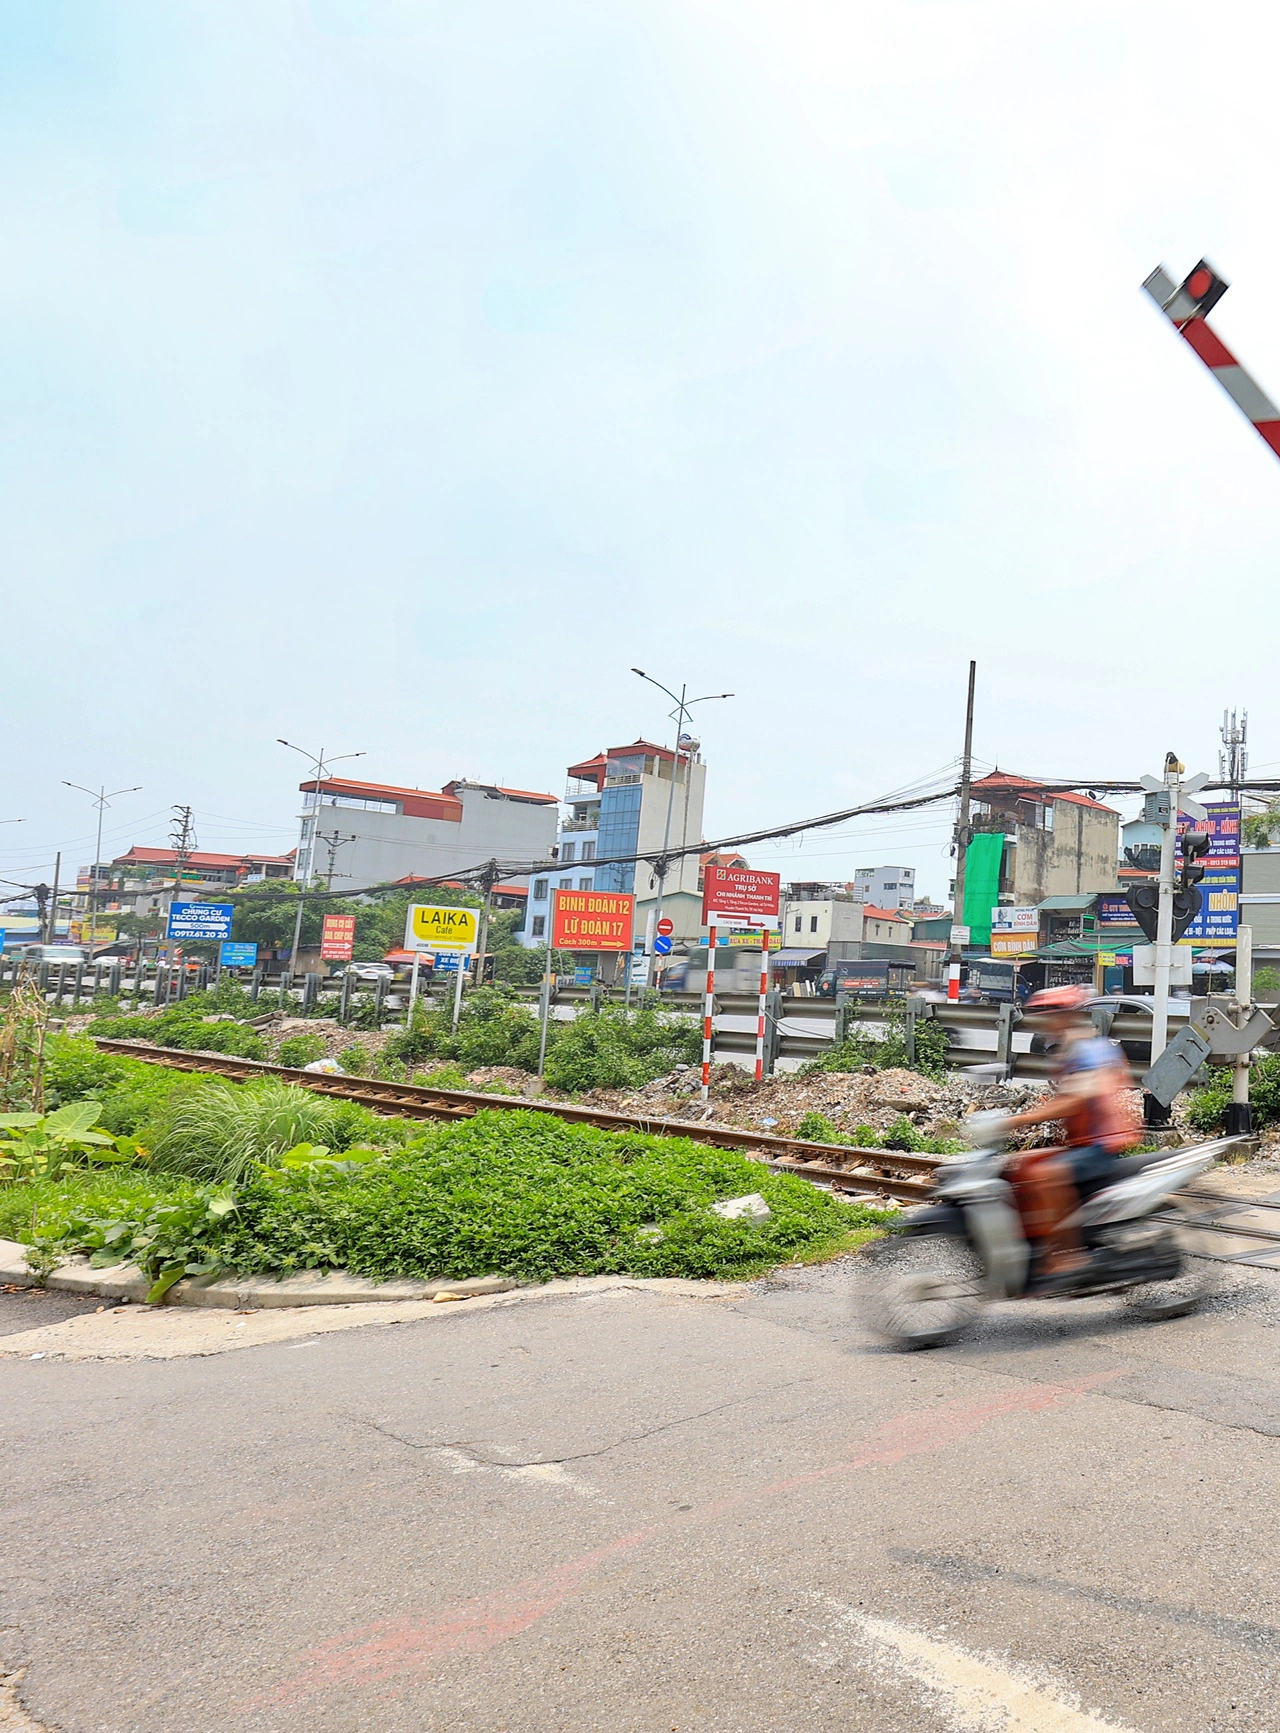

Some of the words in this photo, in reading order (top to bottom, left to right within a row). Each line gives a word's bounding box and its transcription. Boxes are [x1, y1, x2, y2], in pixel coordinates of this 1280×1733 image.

[727, 874, 774, 886] AGRIBANK
[559, 896, 585, 912] BINH
[588, 896, 616, 913] ĐOÀN
[618, 900, 629, 914] 12
[1208, 888, 1237, 912] NHÔM
[421, 910, 468, 926] LAIKA
[564, 916, 579, 934] LỮ
[581, 917, 610, 935] ĐOÀN
[612, 922, 623, 936] 17
